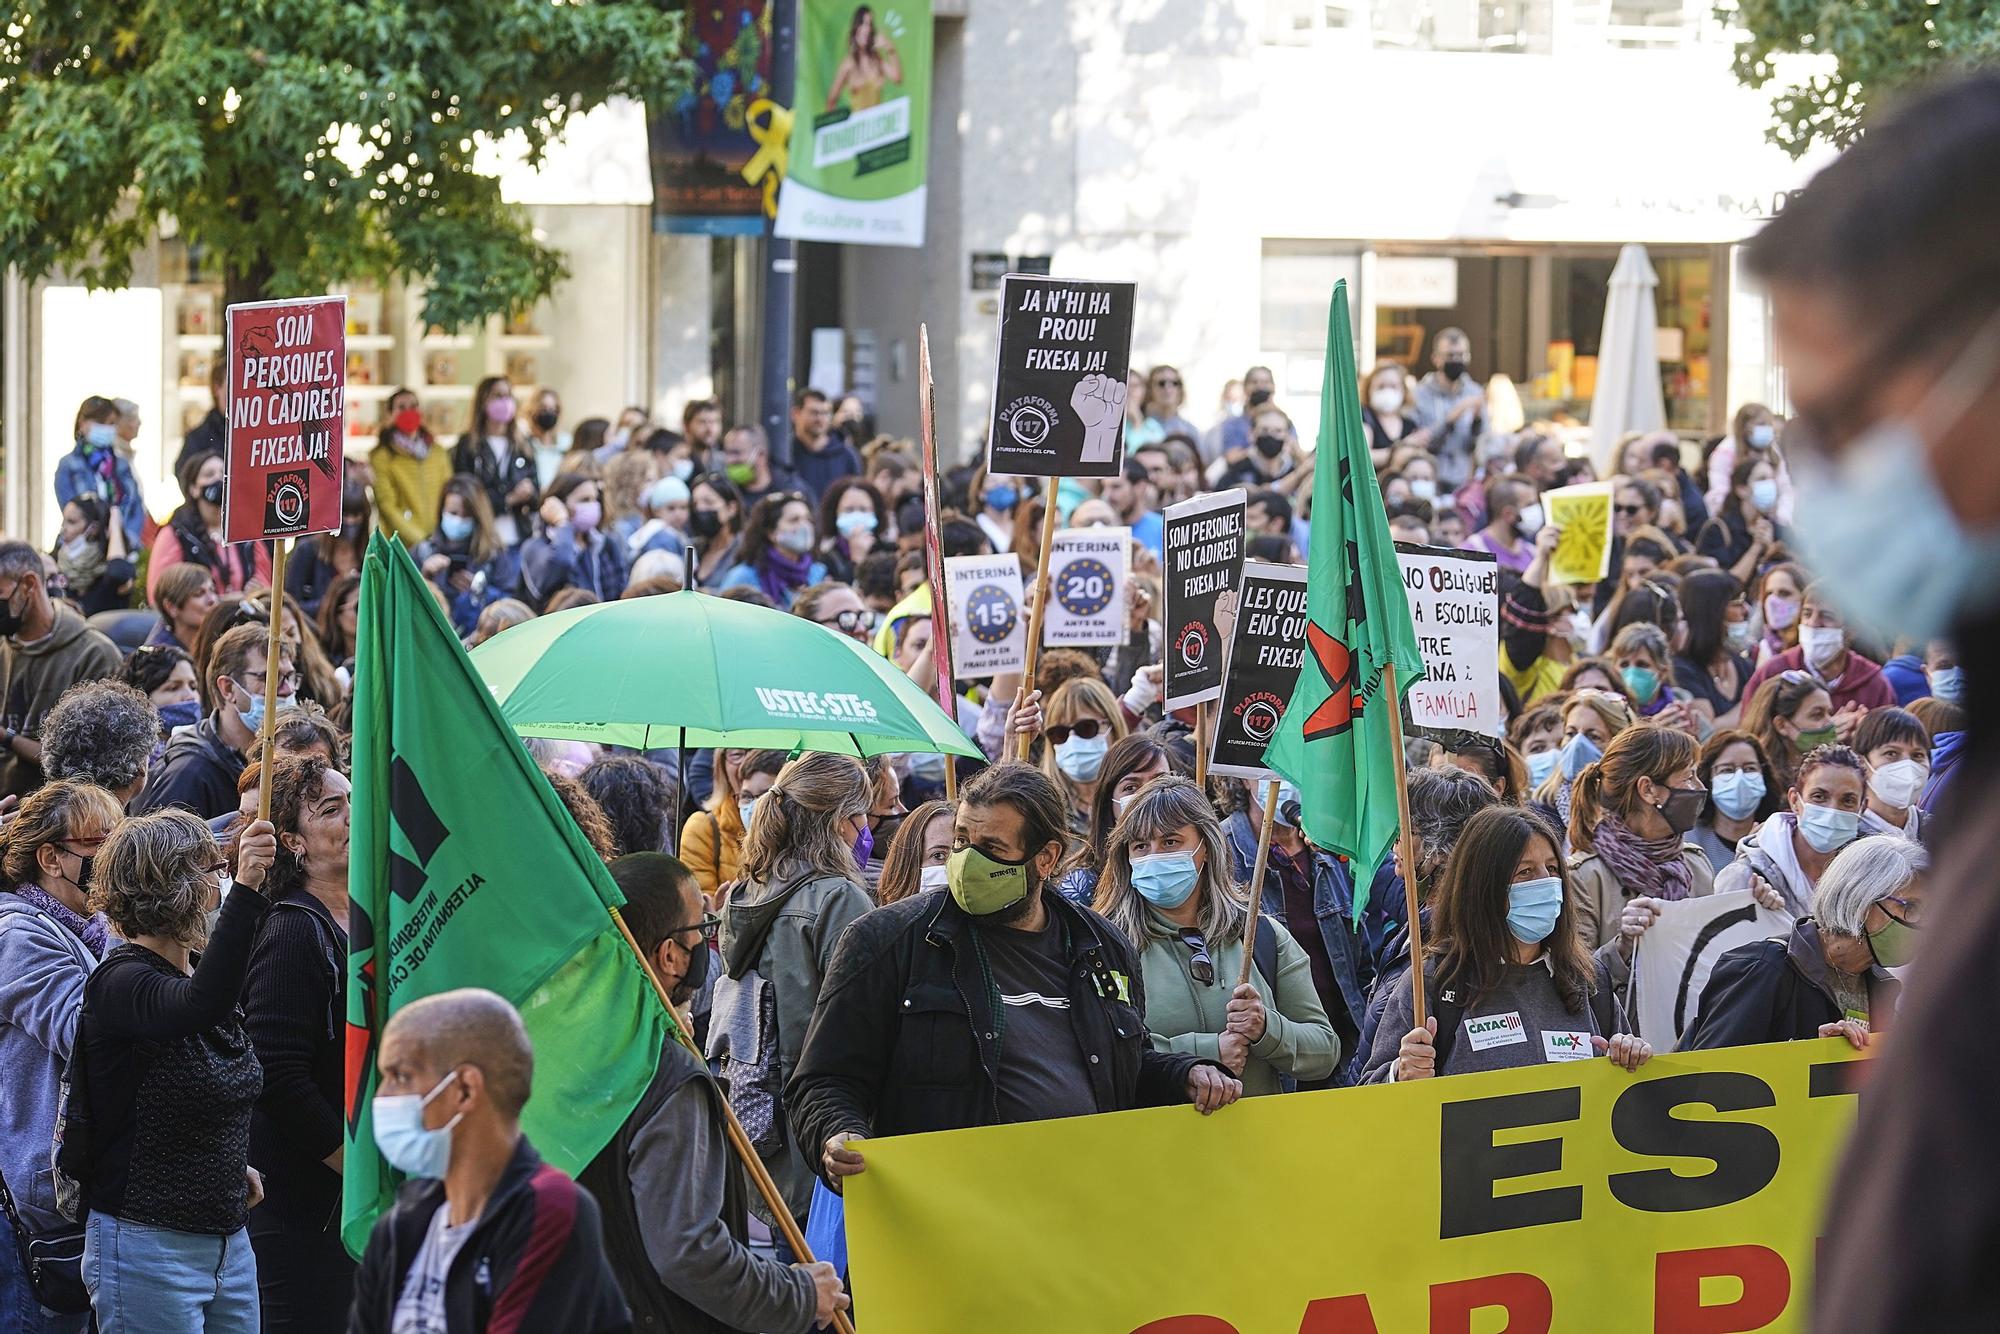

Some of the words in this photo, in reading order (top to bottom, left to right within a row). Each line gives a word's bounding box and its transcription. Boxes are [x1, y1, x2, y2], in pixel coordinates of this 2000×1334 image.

[1019, 289, 1041, 312] JA
[1045, 289, 1086, 314] N'HI
[1087, 292, 1111, 315] HA
[274, 314, 313, 349] SOM
[1038, 317, 1097, 342] PROU!
[242, 349, 338, 390] PERSONES,
[1025, 348, 1080, 371] FIXESA
[1082, 351, 1108, 372] JA!
[233, 395, 263, 429] NO
[267, 386, 345, 426] CADIRES!
[999, 395, 1060, 427] PLATAFORMA
[1016, 420, 1042, 434] 117
[250, 435, 303, 467] FIXESA
[306, 430, 330, 461] JA!
[267, 473, 309, 504] PLATAFORMA
[280, 498, 297, 512] 117
[1168, 524, 1190, 550] SOM
[1191, 512, 1244, 544] PERSONES,
[1177, 549, 1192, 572] NO
[1193, 537, 1237, 568] CADIRES!
[955, 567, 1017, 581] INTERINA
[1184, 573, 1214, 598] FIXESA
[1215, 568, 1229, 590] JA!
[1066, 575, 1104, 599] 20
[1244, 586, 1275, 609] LES
[975, 601, 1009, 628] 15
[1415, 601, 1424, 623] A
[1174, 620, 1209, 650] PLATAFORMA
[1247, 613, 1279, 636] ENS
[1281, 617, 1306, 642] QU
[974, 648, 997, 656] ANYS
[999, 646, 1010, 654] EN
[1185, 643, 1200, 655] 117
[1257, 645, 1305, 669] FIXESA
[1418, 637, 1452, 657] TRE
[963, 661, 985, 669] FRAU
[1247, 715, 1272, 729] 117
[1468, 1019, 1508, 1034] CATAC
